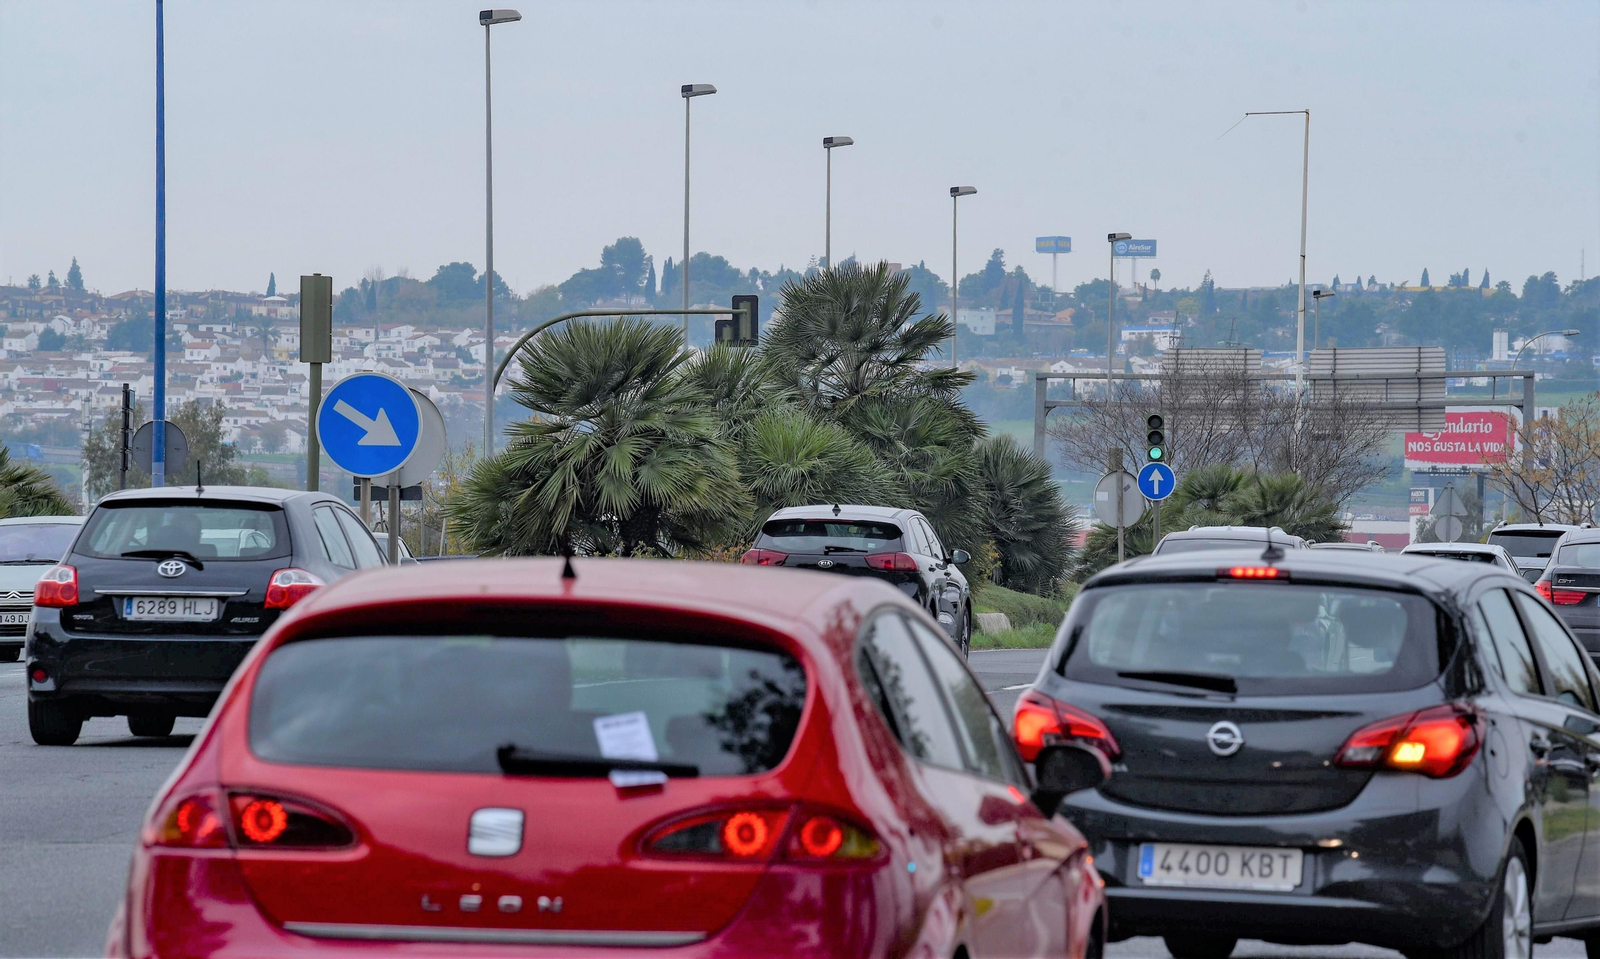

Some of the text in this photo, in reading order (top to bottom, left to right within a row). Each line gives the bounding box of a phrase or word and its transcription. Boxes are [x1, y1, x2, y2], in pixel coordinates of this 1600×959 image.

[1408, 442, 1431, 452] NOS
[1434, 442, 1466, 452] GUSTA
[1468, 442, 1481, 452] LA
[137, 600, 214, 615] 6289 HLJ
[1159, 850, 1293, 878] 4400 KBT
[421, 893, 563, 913] LEON
